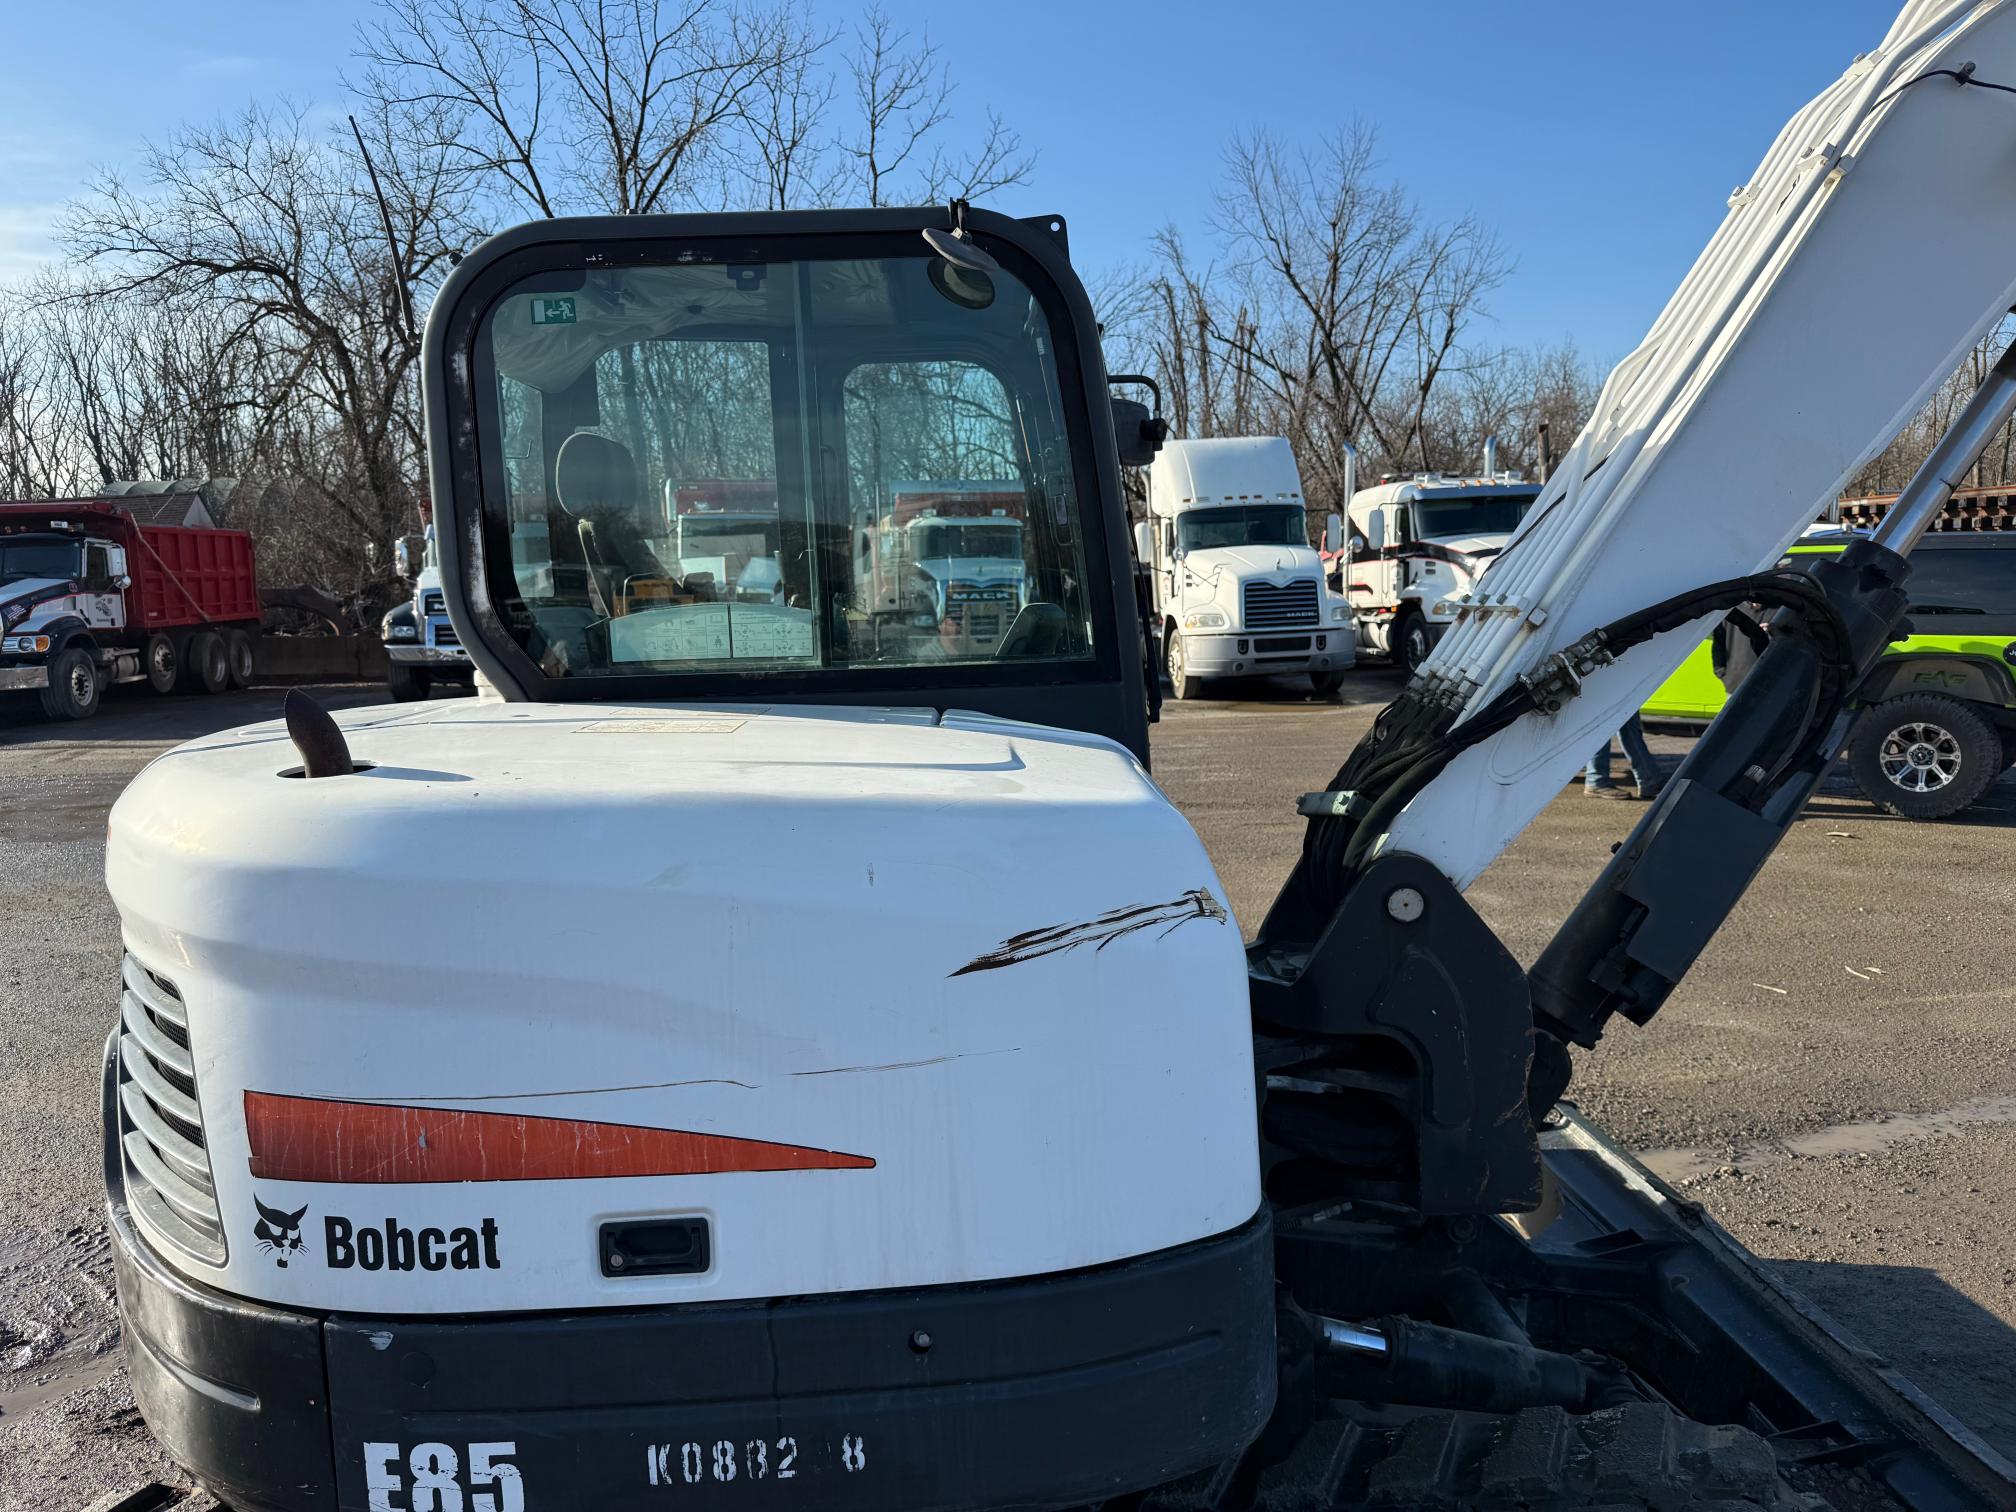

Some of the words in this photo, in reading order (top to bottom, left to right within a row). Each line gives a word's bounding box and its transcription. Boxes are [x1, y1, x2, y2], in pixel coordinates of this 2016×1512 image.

[952, 592, 1010, 600] MACK
[324, 1216, 501, 1271] Bobcat
[363, 1442, 526, 1512] E85
